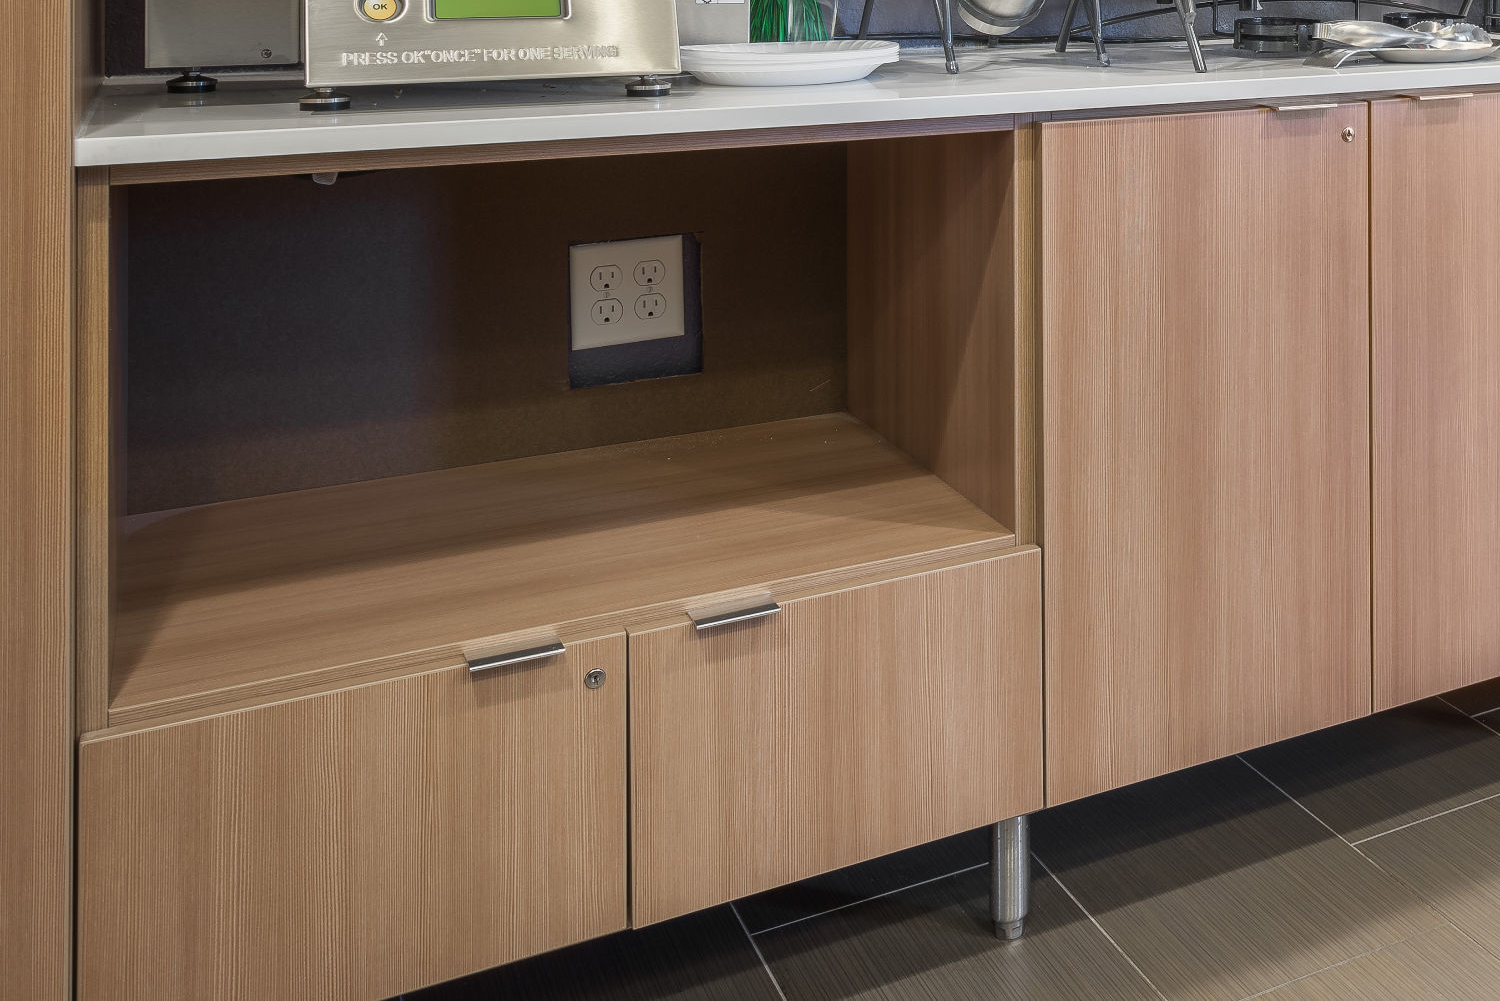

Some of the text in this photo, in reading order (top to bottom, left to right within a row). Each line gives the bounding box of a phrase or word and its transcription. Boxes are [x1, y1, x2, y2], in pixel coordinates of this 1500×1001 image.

[341, 51, 398, 66] PRESS
[483, 48, 516, 62] FOR
[518, 47, 551, 60] ONE
[553, 45, 619, 60] SERVING
